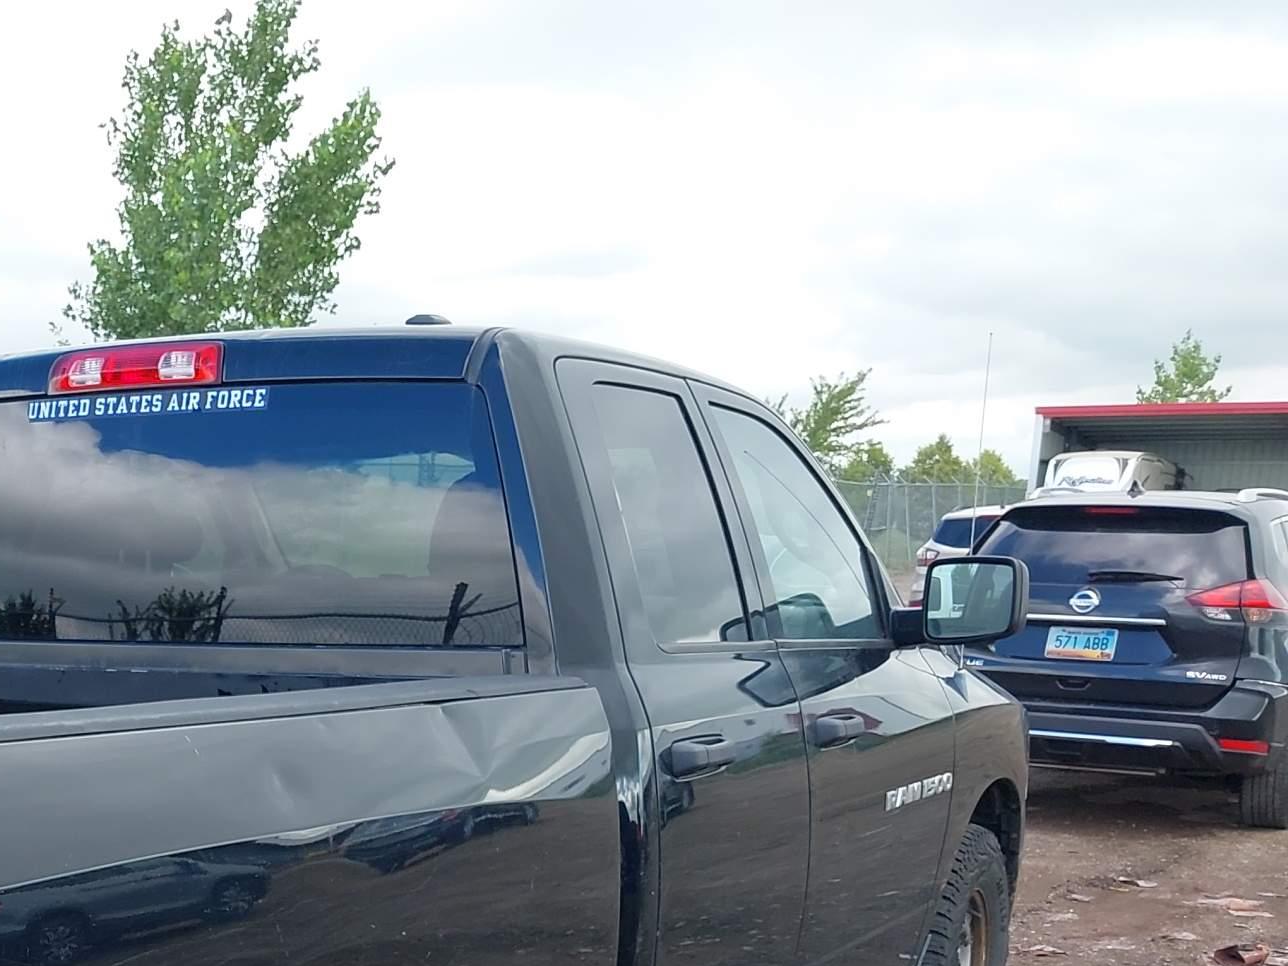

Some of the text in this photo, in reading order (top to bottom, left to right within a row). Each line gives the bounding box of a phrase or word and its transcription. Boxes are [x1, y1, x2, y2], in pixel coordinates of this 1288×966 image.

[28, 388, 267, 420] UNITED STATES AIR FORCE
[1054, 634, 1110, 651] 571 ABB
